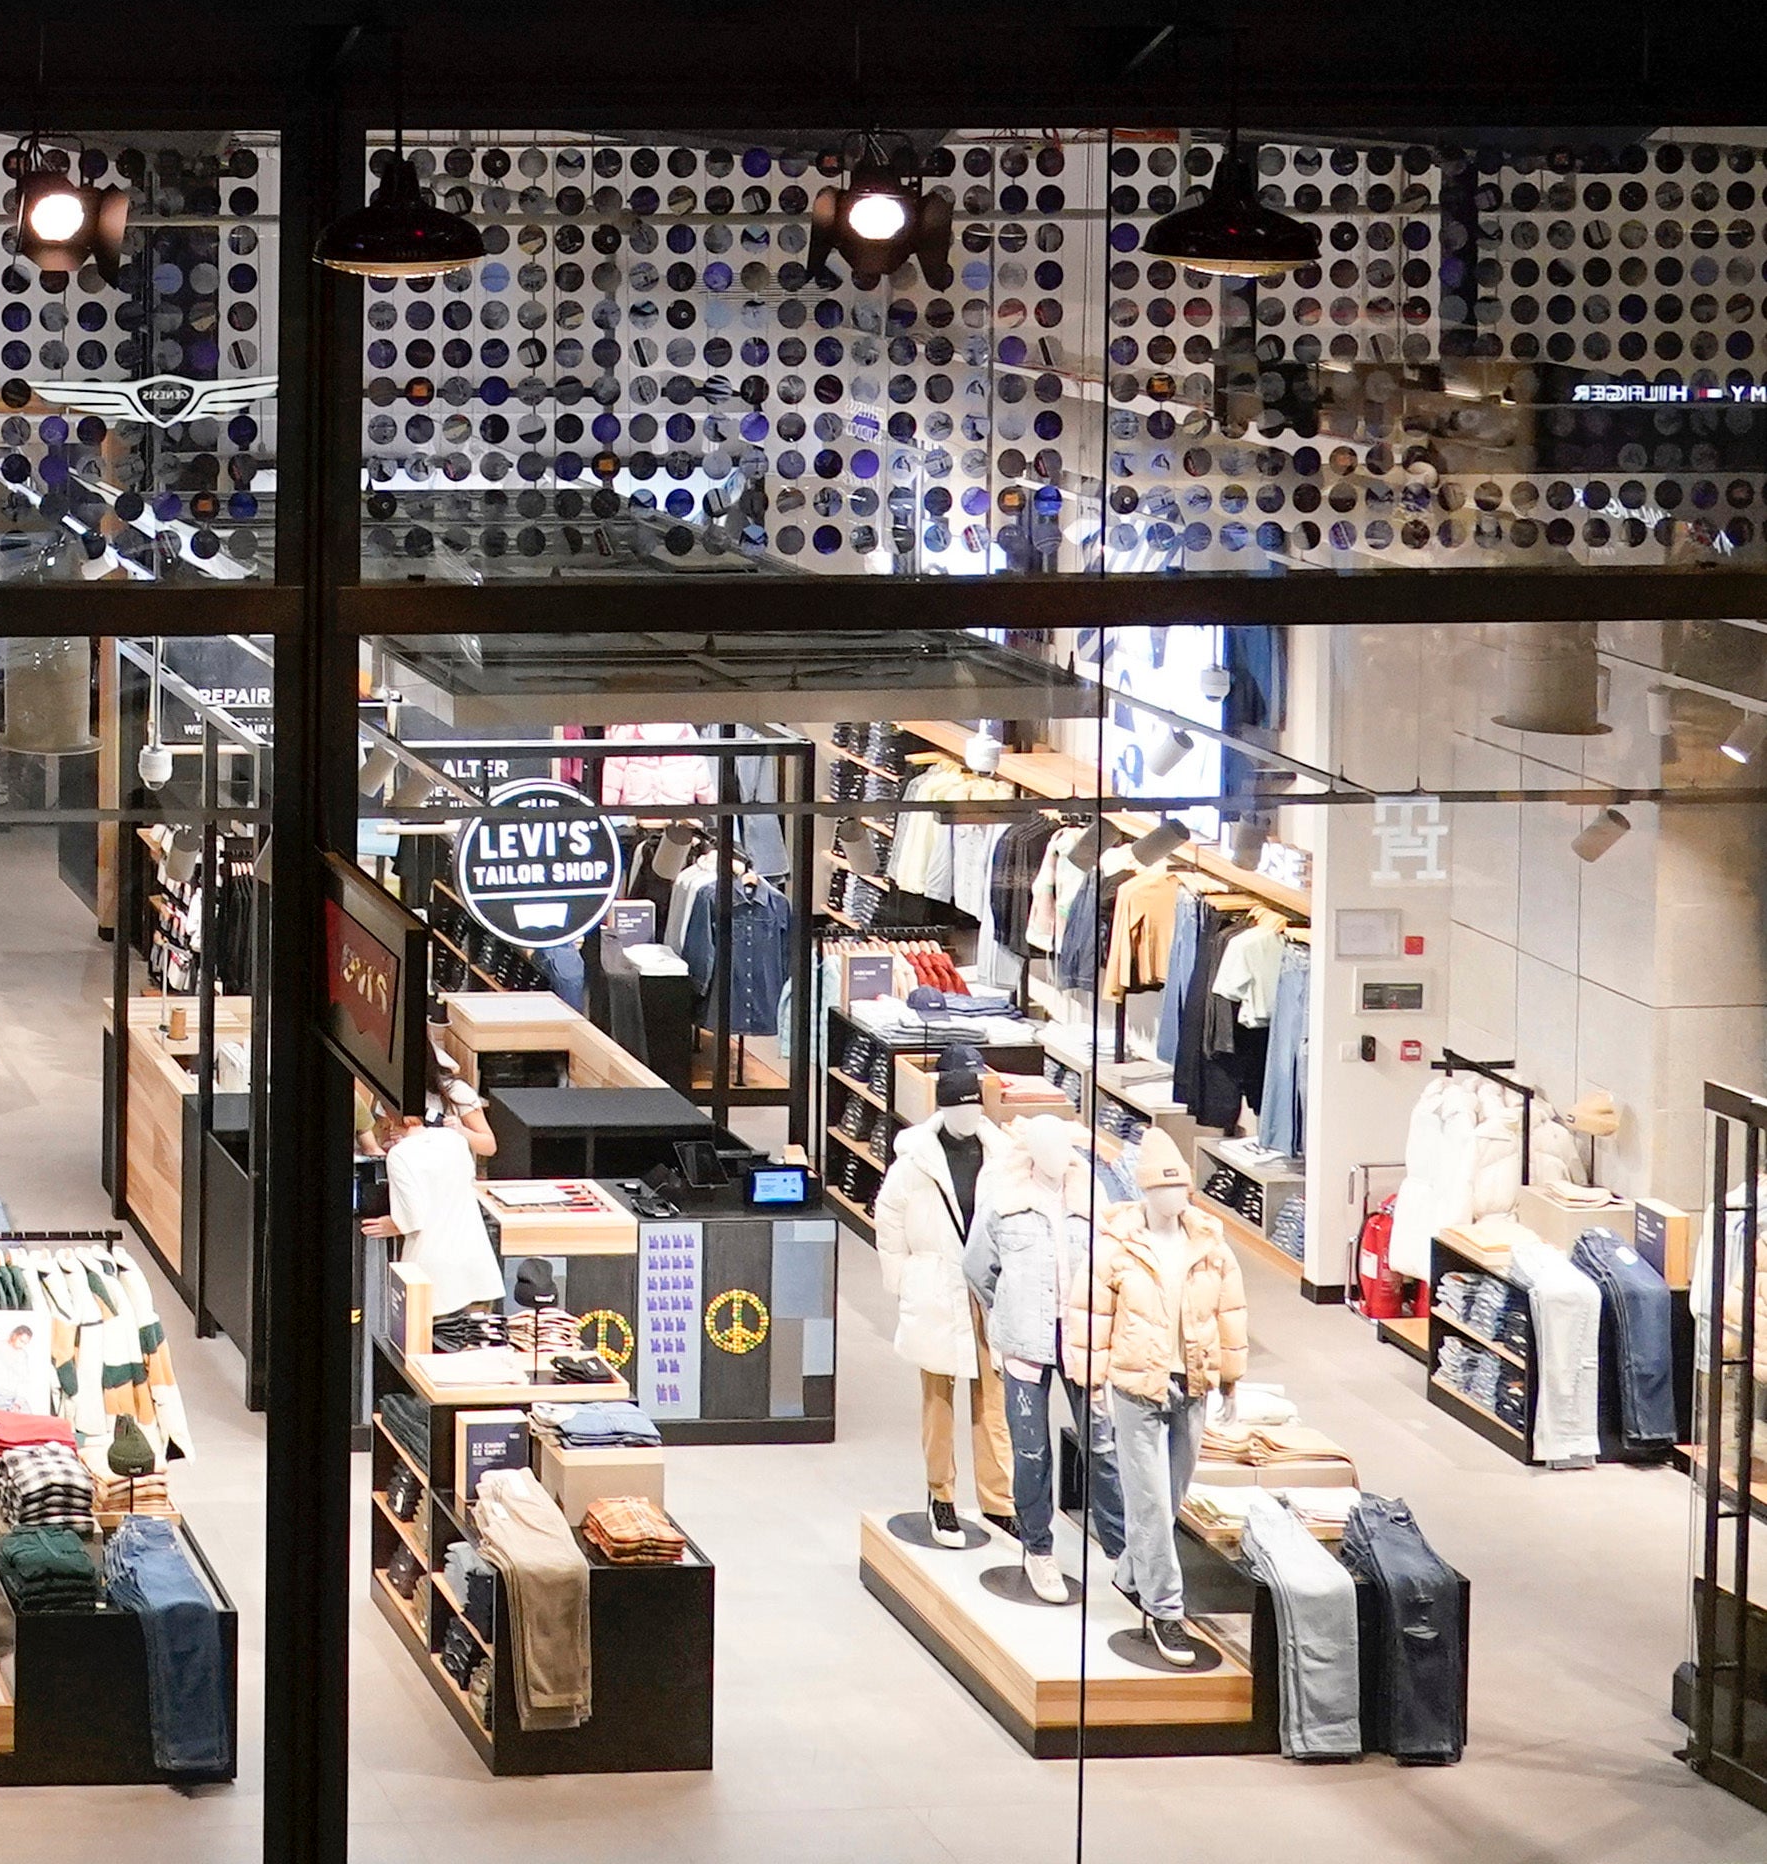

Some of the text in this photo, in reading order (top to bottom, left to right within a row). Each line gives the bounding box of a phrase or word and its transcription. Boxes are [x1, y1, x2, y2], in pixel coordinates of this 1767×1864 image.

[198, 687, 271, 705] REPAIR
[473, 860, 608, 886] TAILOR SHOP
